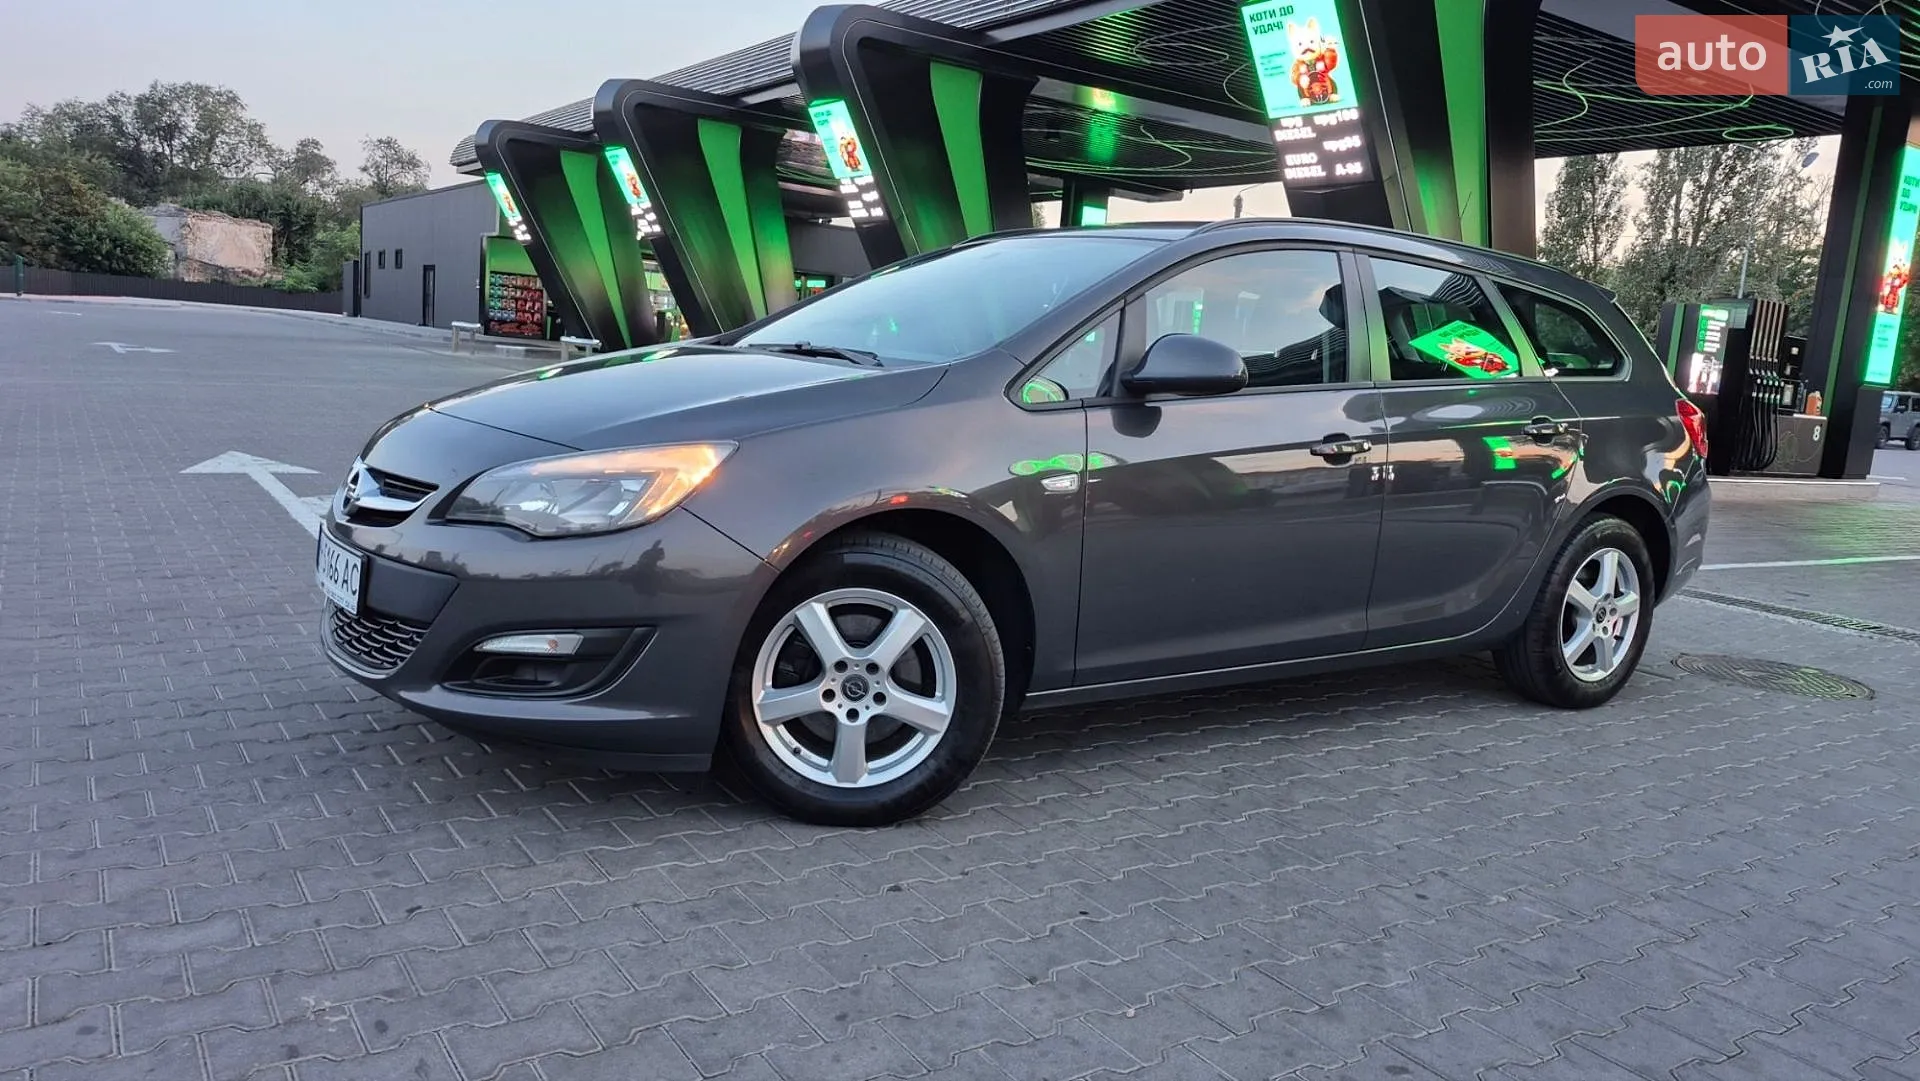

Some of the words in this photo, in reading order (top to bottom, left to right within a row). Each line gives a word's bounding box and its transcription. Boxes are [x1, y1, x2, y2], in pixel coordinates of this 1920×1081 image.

[1249, 9, 1277, 23] КОТИ
[1280, 5, 1294, 17] ДО
[1252, 21, 1284, 35] УДАЧІ
[1812, 425, 1821, 441] 8
